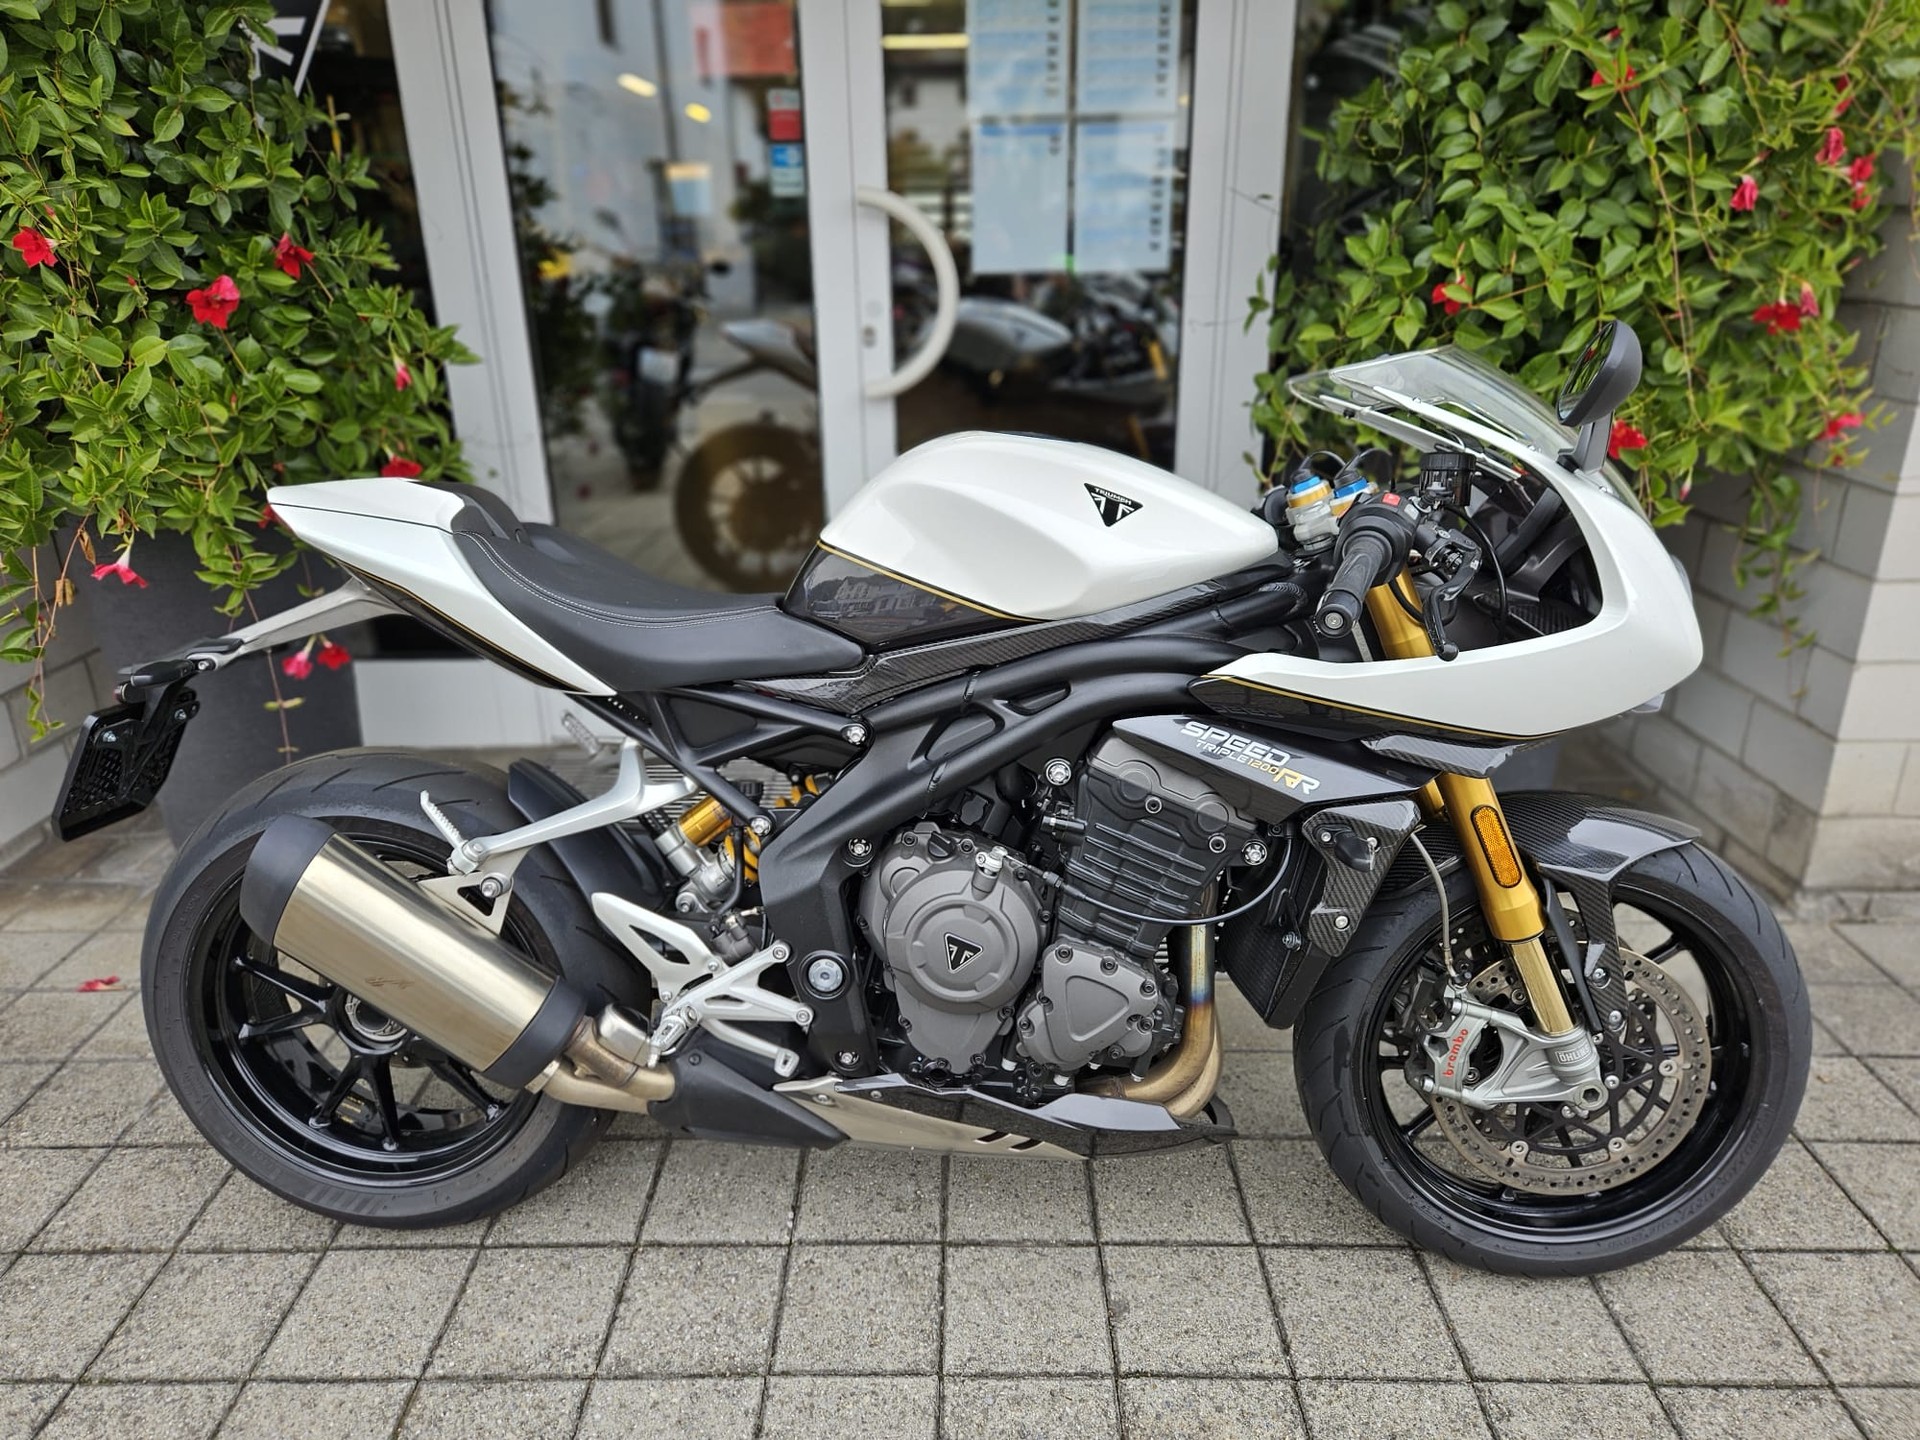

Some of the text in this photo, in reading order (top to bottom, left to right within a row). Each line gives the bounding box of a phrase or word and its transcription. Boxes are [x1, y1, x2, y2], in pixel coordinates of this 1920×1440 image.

[1180, 721, 1291, 766] SPEED
[1273, 767, 1321, 794] RR
[1442, 1028, 1469, 1077] brembo
